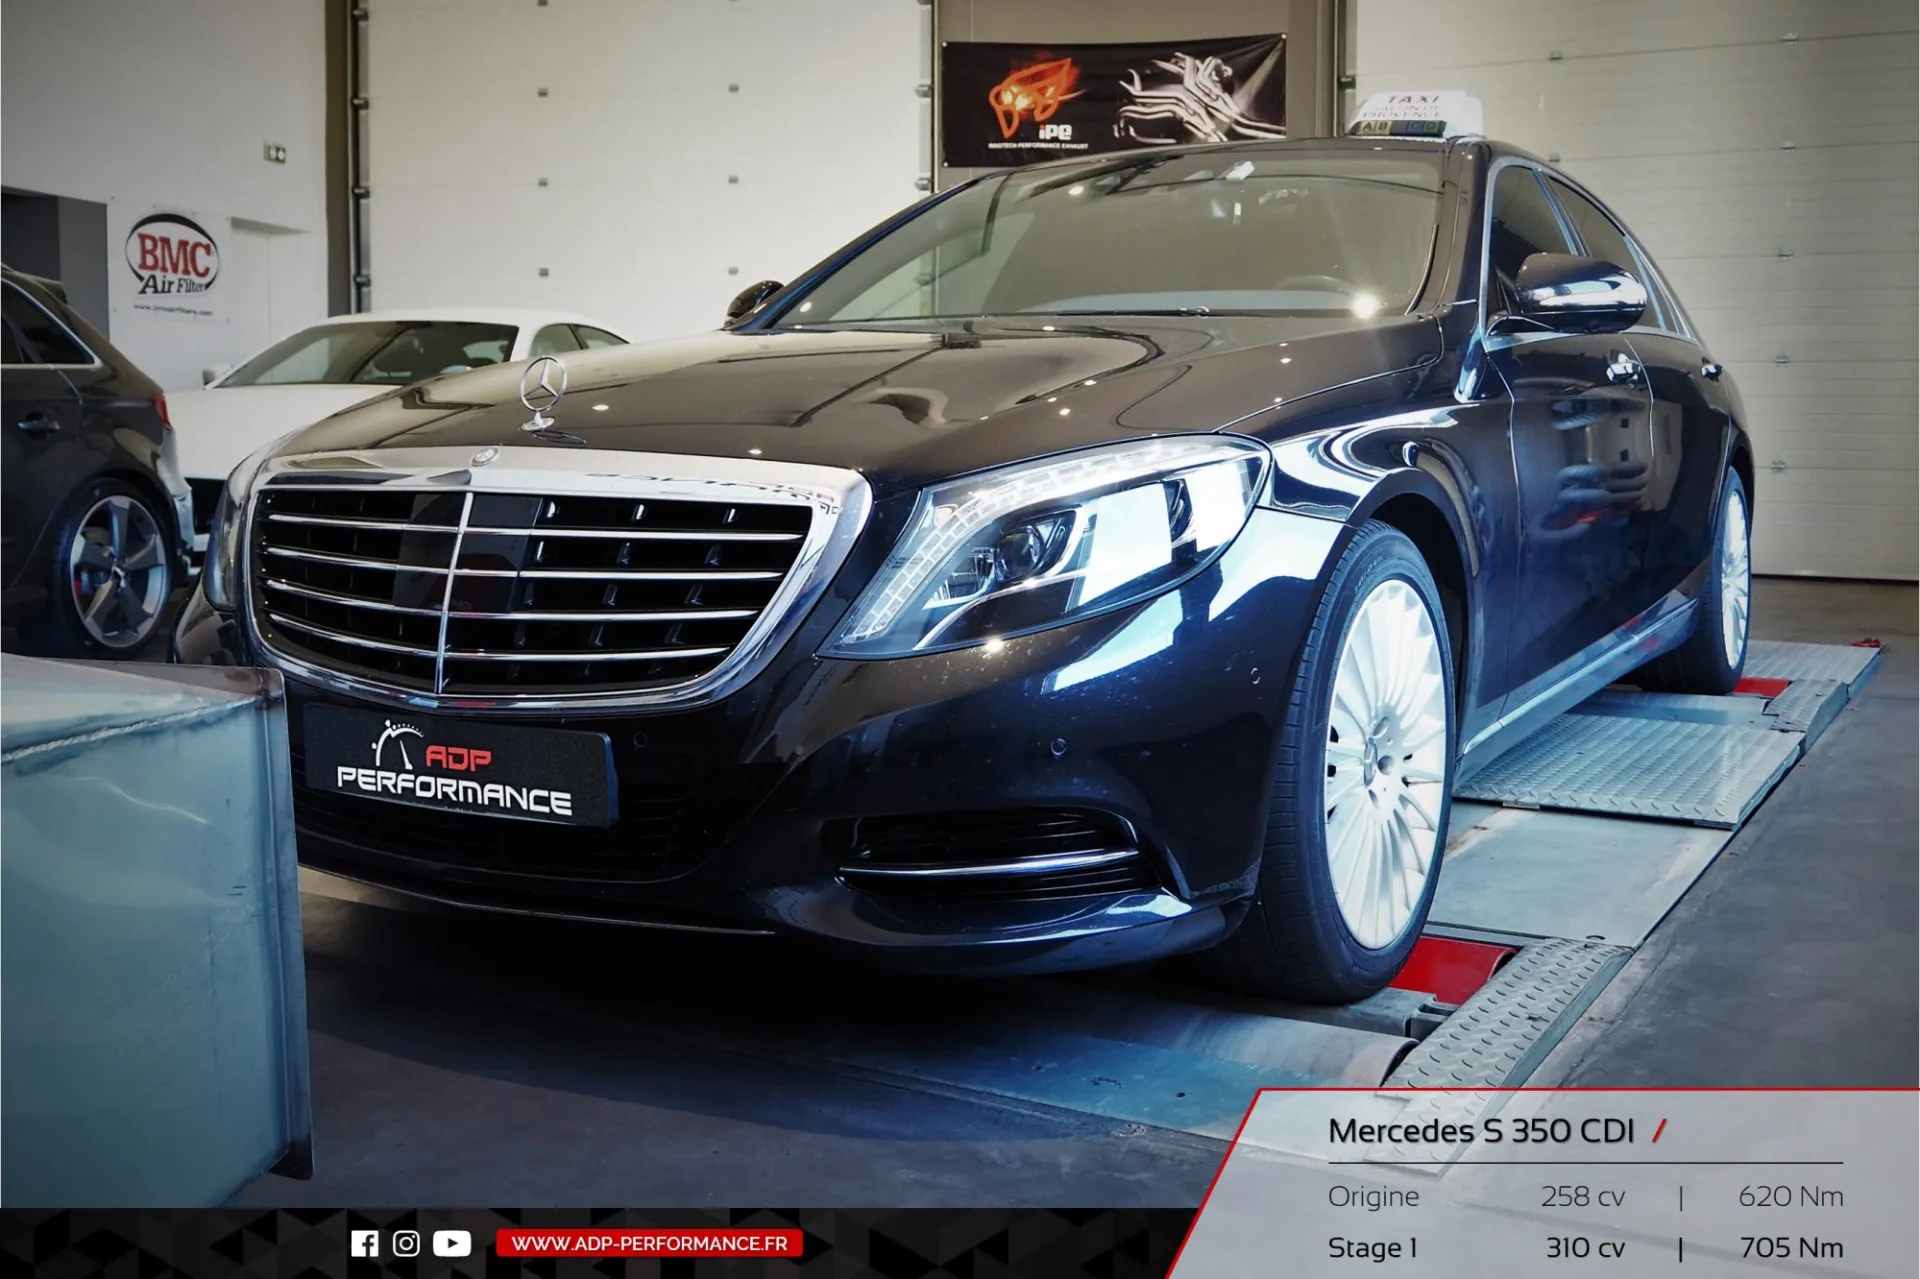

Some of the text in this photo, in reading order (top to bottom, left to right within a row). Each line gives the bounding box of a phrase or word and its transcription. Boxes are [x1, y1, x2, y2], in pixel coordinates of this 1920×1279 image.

[1388, 95, 1441, 104] TAXI
[137, 232, 211, 278] BMC
[138, 274, 174, 294] Air
[426, 745, 492, 772] ADP
[337, 766, 572, 816] PERFORMANCE
